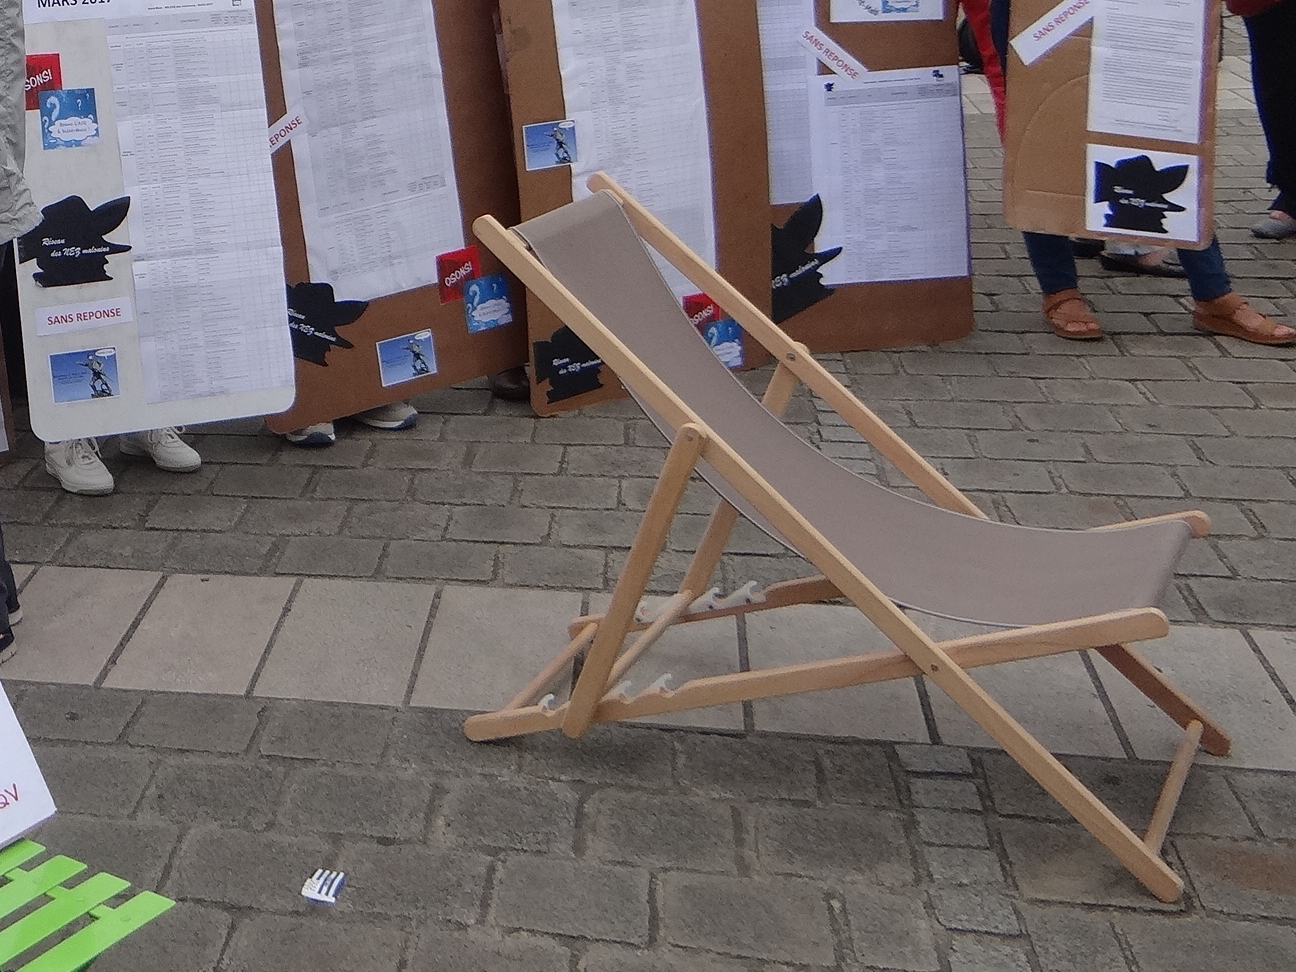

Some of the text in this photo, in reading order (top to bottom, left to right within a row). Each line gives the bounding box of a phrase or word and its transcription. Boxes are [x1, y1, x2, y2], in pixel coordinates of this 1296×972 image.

[1032, 21, 1056, 42] SANS
[802, 30, 860, 80] SANS REPONSE
[24, 68, 53, 91] SONS!
[269, 115, 303, 148] EPONSE
[41, 237, 66, 246] Réseau
[50, 249, 62, 258] des
[62, 246, 81, 258] NEZ
[443, 260, 473, 288] OSONS!
[47, 307, 122, 326] SANS REPONSE
